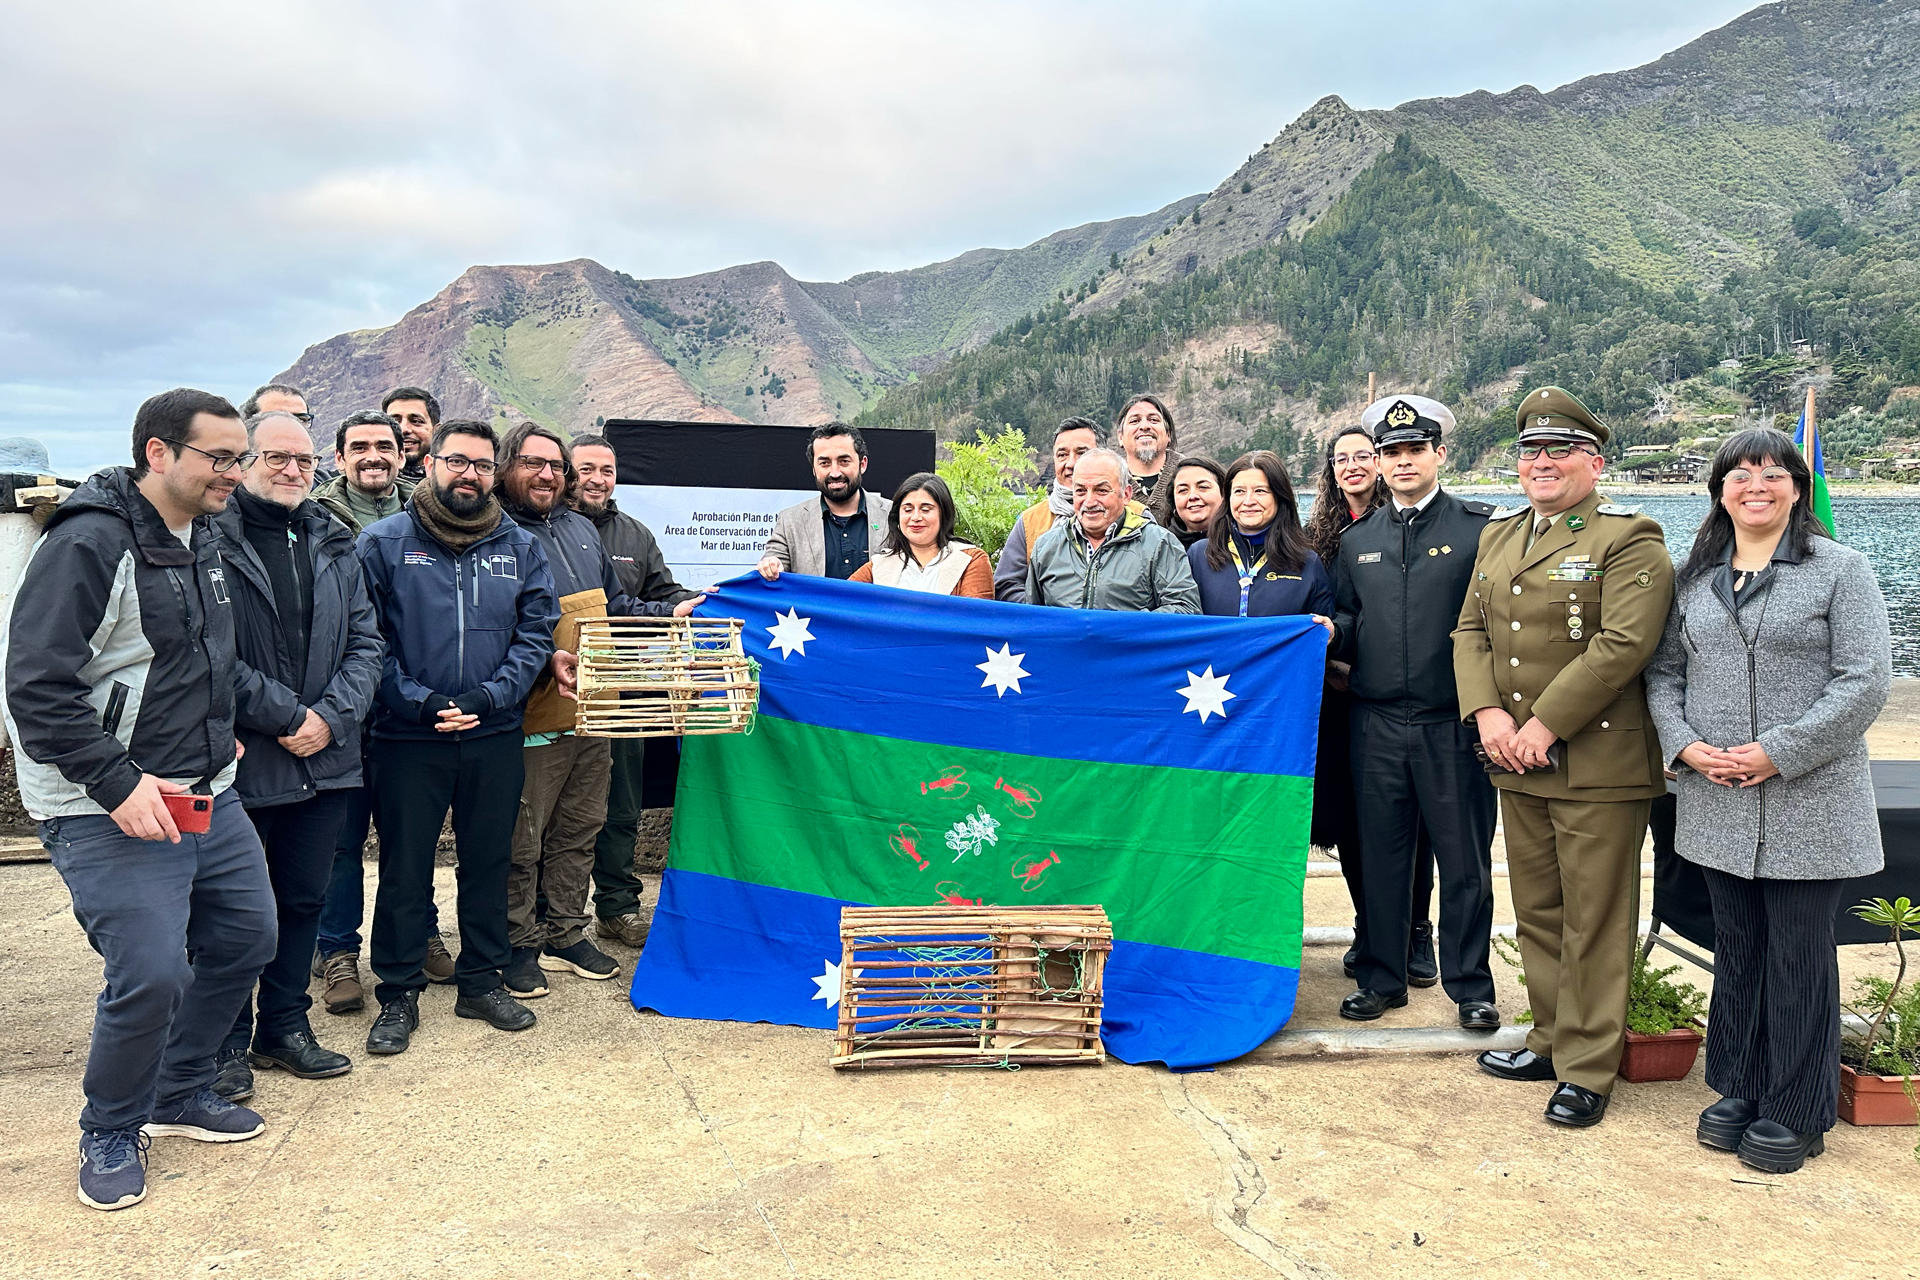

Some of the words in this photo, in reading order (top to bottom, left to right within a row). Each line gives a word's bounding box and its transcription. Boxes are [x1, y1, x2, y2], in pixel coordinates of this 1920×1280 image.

[692, 511, 741, 523] Aprobación
[743, 512, 761, 522] Plan
[763, 513, 774, 522] de
[664, 523, 685, 535] Área
[687, 525, 698, 536] de
[699, 526, 756, 537] Conservación
[758, 527, 769, 537] de
[701, 541, 717, 550] Mar
[719, 541, 730, 551] de
[732, 541, 751, 551] Juan
